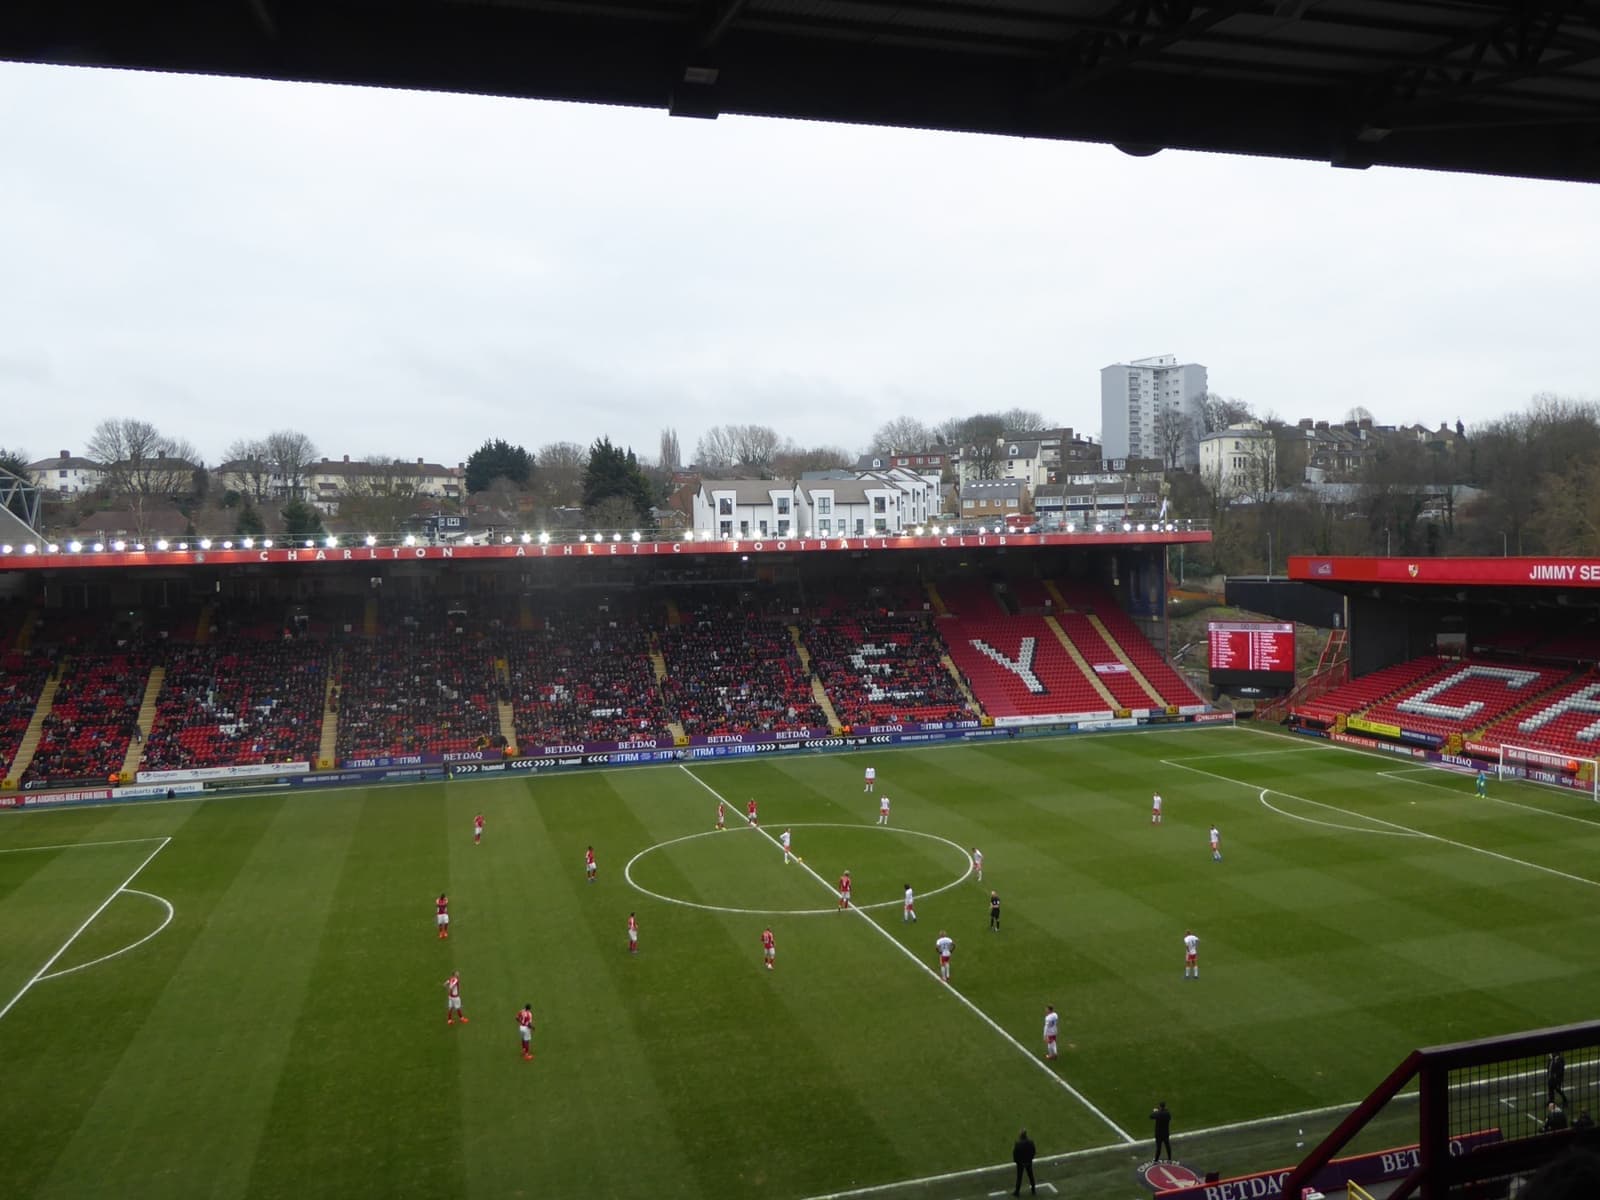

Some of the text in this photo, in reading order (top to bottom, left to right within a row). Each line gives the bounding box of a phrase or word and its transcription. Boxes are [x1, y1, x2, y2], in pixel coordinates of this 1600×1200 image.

[260, 536, 1006, 561] CHARLTON ATHLETIC FOOTBALL CLUB
[1529, 565, 1576, 580] JIMMY
[870, 724, 903, 733] BETDAQ
[707, 735, 742, 743] BETDAQ
[776, 730, 810, 739] BETDAQ
[545, 745, 584, 754] BETDAQ
[618, 740, 657, 749] BETDAQ
[443, 752, 483, 761] BETDAQ
[617, 753, 639, 762] ITRM
[693, 747, 714, 757] ITRM
[735, 744, 756, 753] ITRM
[354, 756, 421, 768] ITRM ITRM
[1442, 754, 1472, 767] BETDAQ
[1535, 771, 1556, 783] ITRM
[1562, 776, 1586, 787] sky bet
[1381, 1139, 1464, 1173] BETQ
